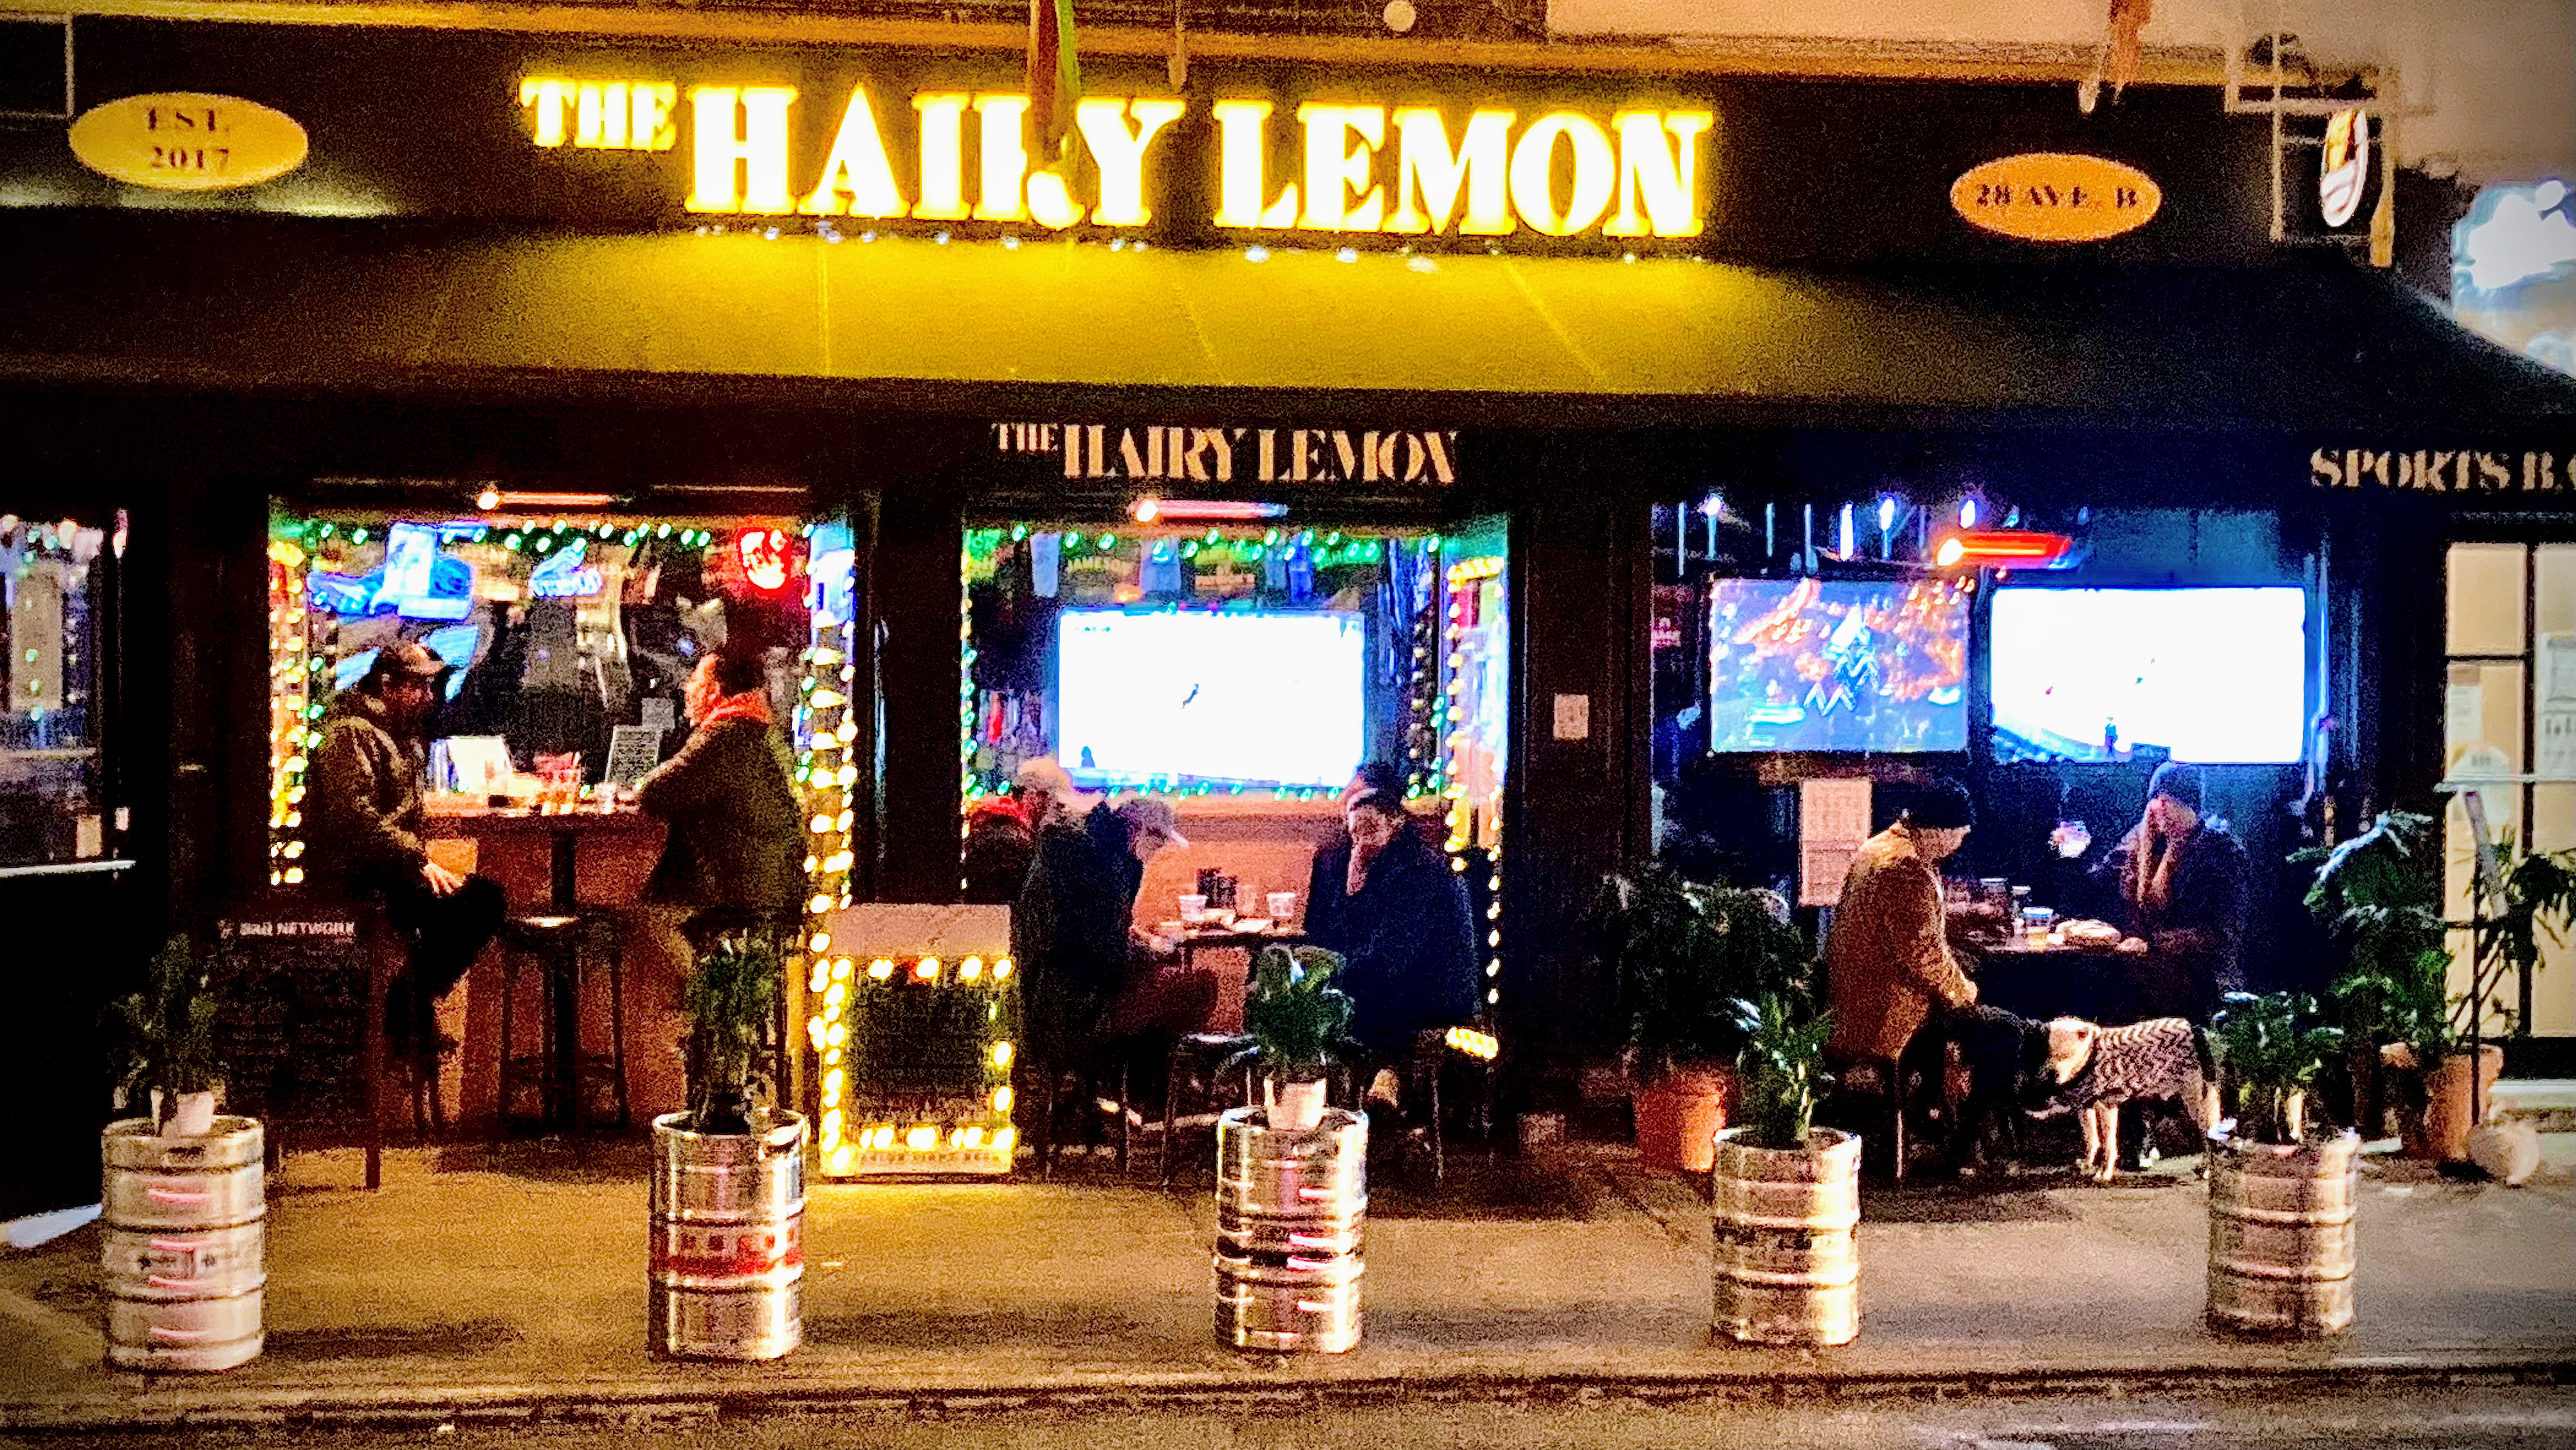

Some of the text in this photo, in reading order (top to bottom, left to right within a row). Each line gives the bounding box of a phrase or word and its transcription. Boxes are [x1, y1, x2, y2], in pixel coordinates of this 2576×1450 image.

[151, 145, 230, 170] 2017
[518, 77, 677, 152] THE
[1212, 99, 1715, 239] LEMON
[992, 423, 1461, 485] THE HAIRY LEMON
[2310, 448, 2511, 493] SPORTS
